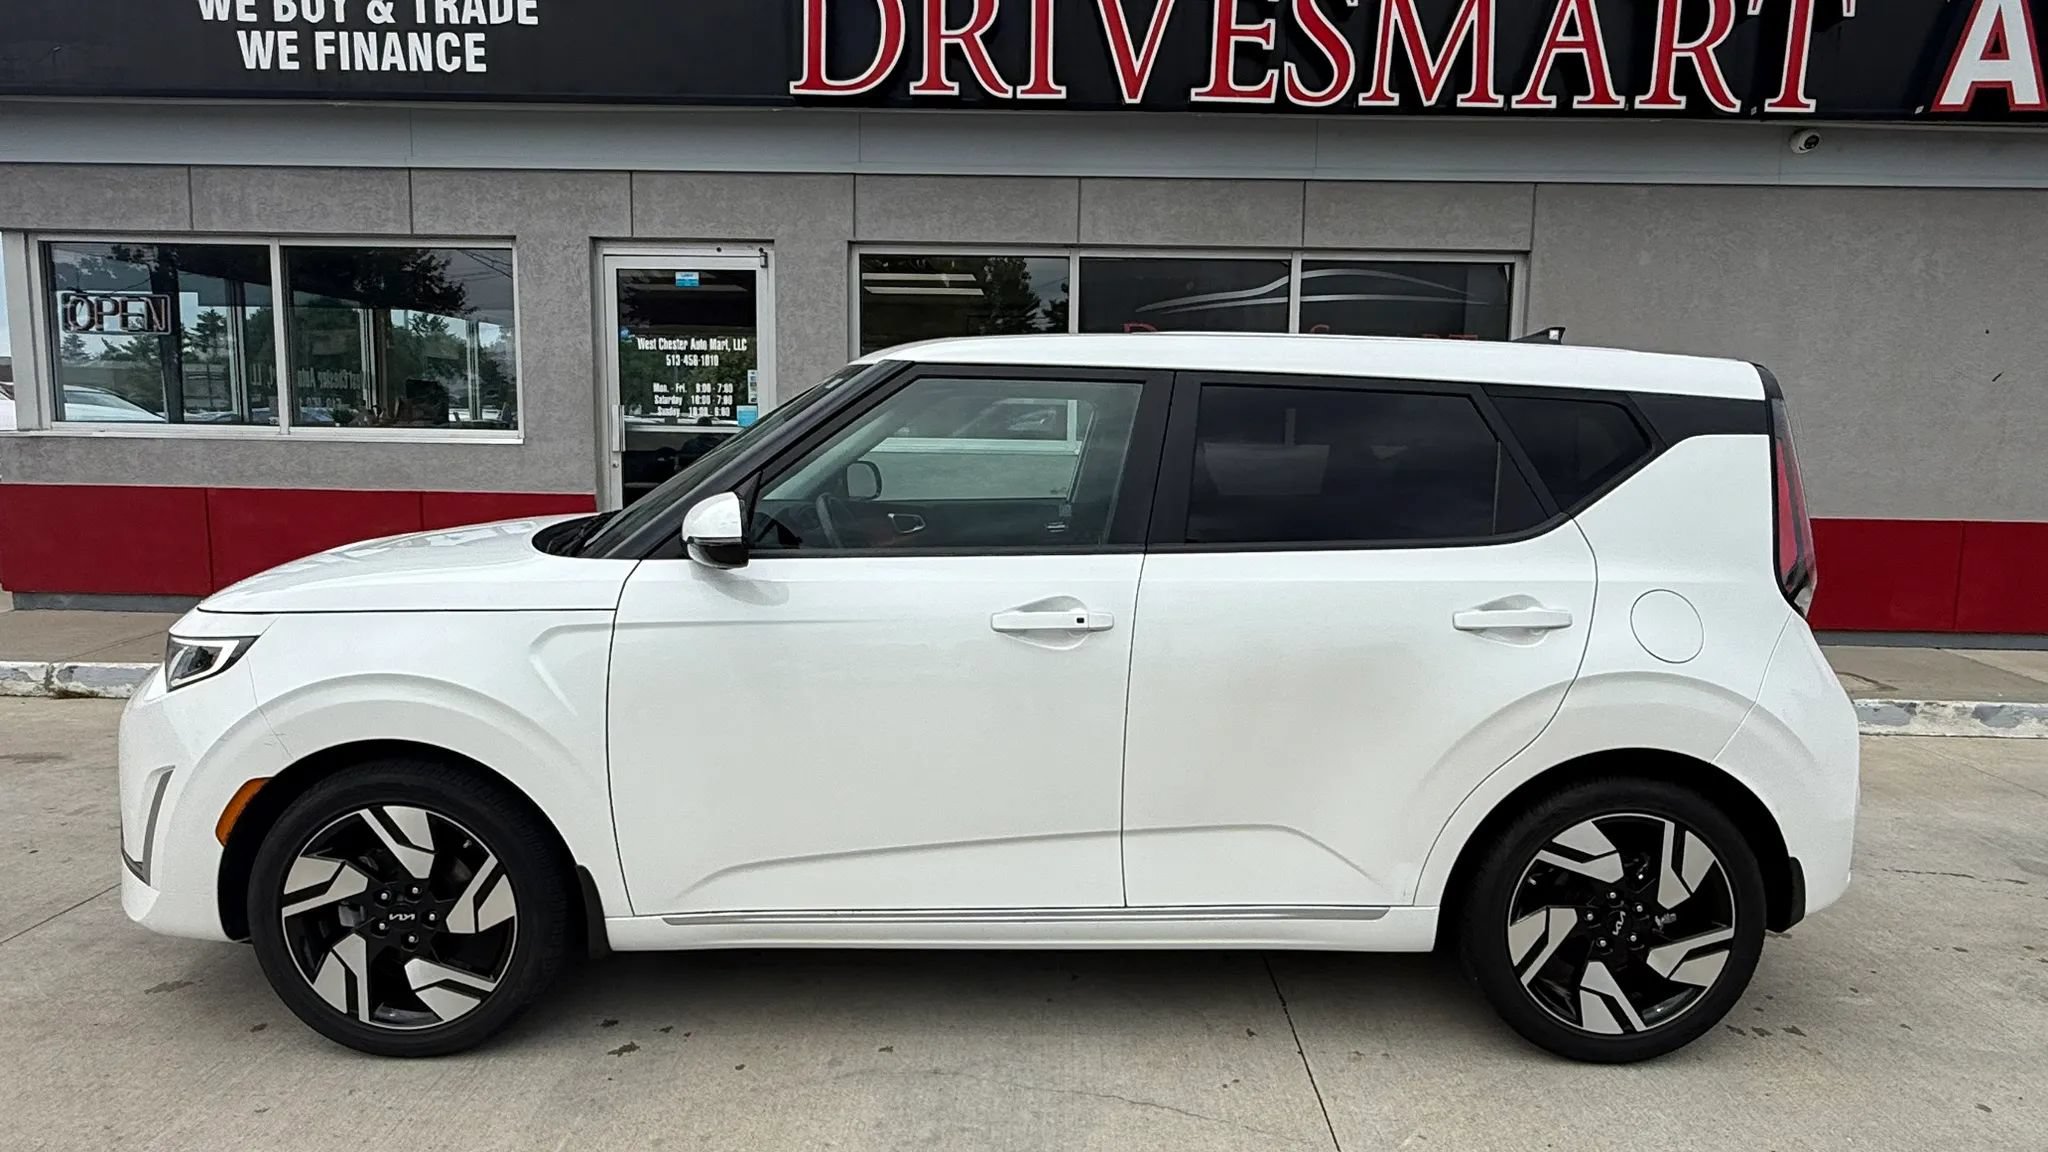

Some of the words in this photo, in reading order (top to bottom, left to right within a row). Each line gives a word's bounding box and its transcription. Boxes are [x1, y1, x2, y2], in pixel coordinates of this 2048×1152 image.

[198, 0, 258, 22] WE
[273, 0, 346, 24] BUY
[366, 0, 396, 25] &
[416, 0, 539, 25] TRADE
[237, 30, 300, 71] WE
[314, 31, 487, 73] FINANCE
[789, 0, 1856, 113] DRIVESMART
[66, 295, 168, 333] OPEN
[636, 337, 657, 351] West
[658, 337, 688, 351] Chester
[690, 337, 708, 351] Auto
[709, 338, 731, 352] Mart,
[733, 338, 748, 351] LLC
[654, 394, 683, 406] Saturday
[657, 406, 680, 417] Sunday
